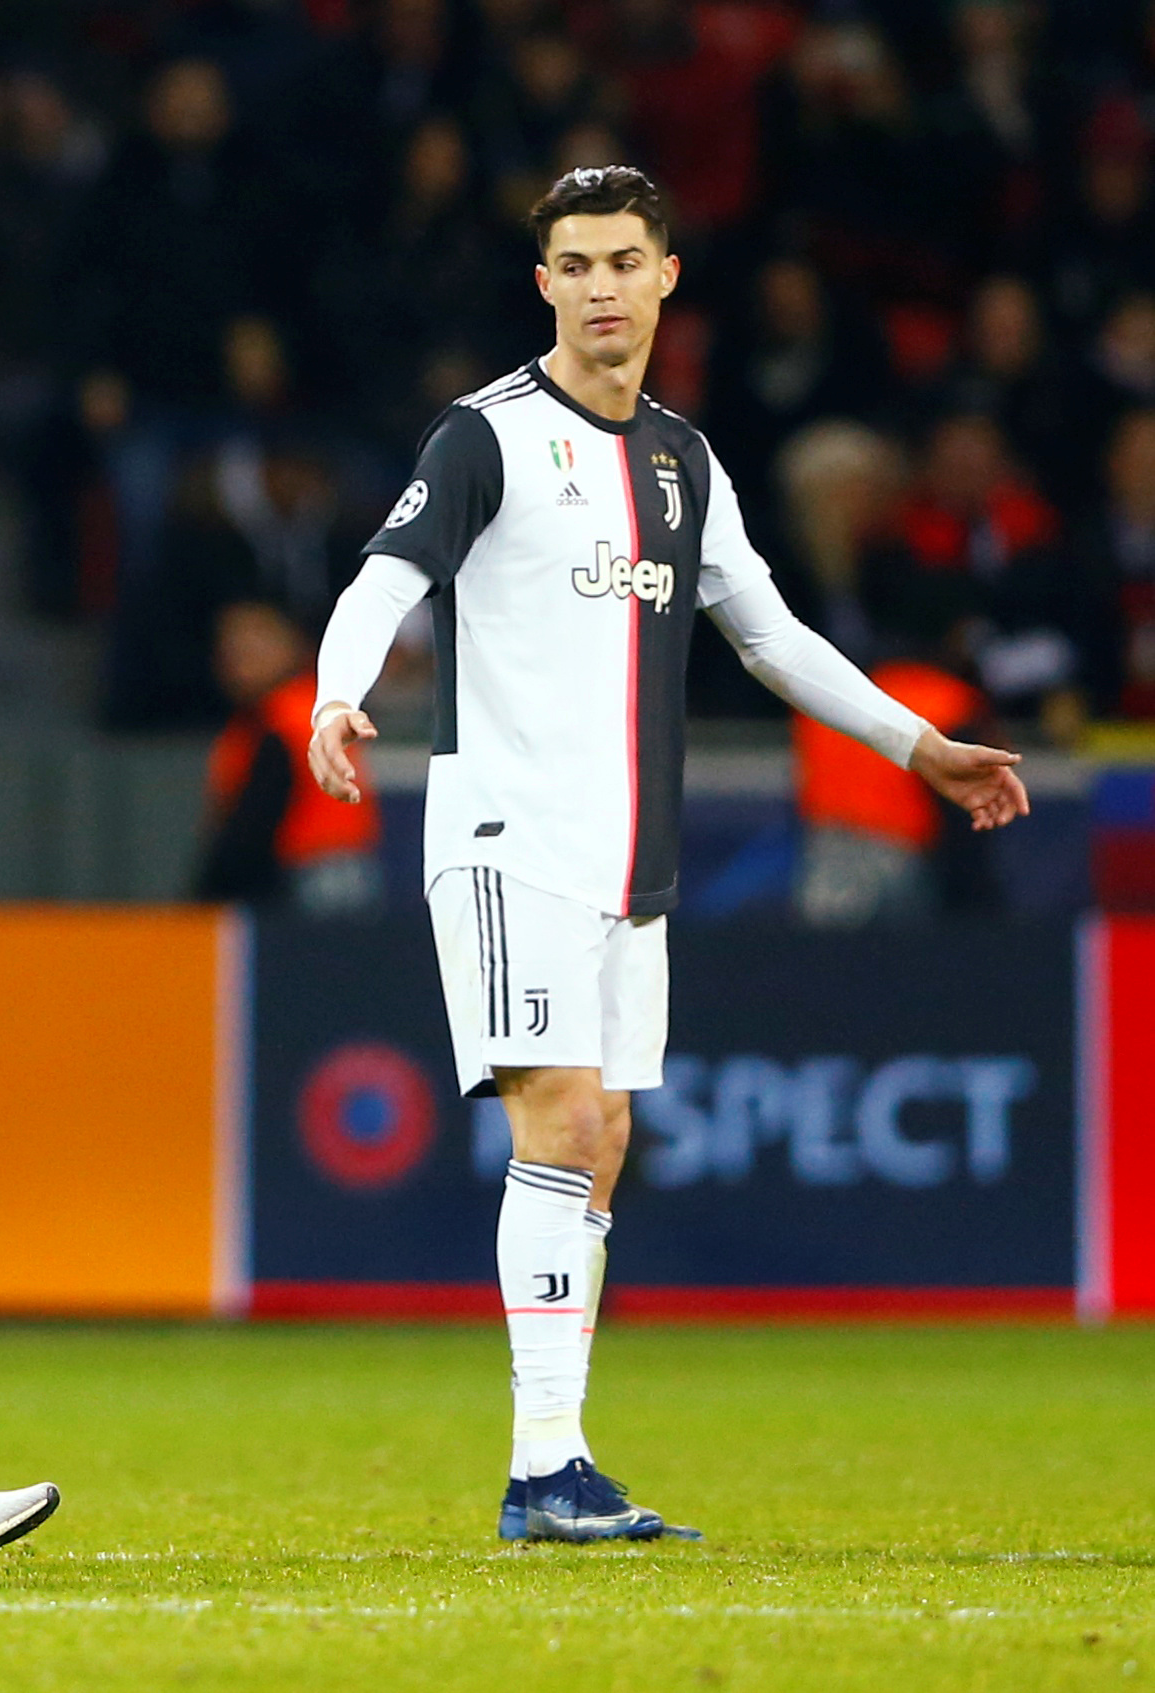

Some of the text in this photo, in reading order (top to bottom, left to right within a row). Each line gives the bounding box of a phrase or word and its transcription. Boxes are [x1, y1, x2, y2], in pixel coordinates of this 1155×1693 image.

[555, 496, 589, 506] adidas
[571, 540, 675, 615] Jeep
[470, 1052, 1038, 1188] SPECT
